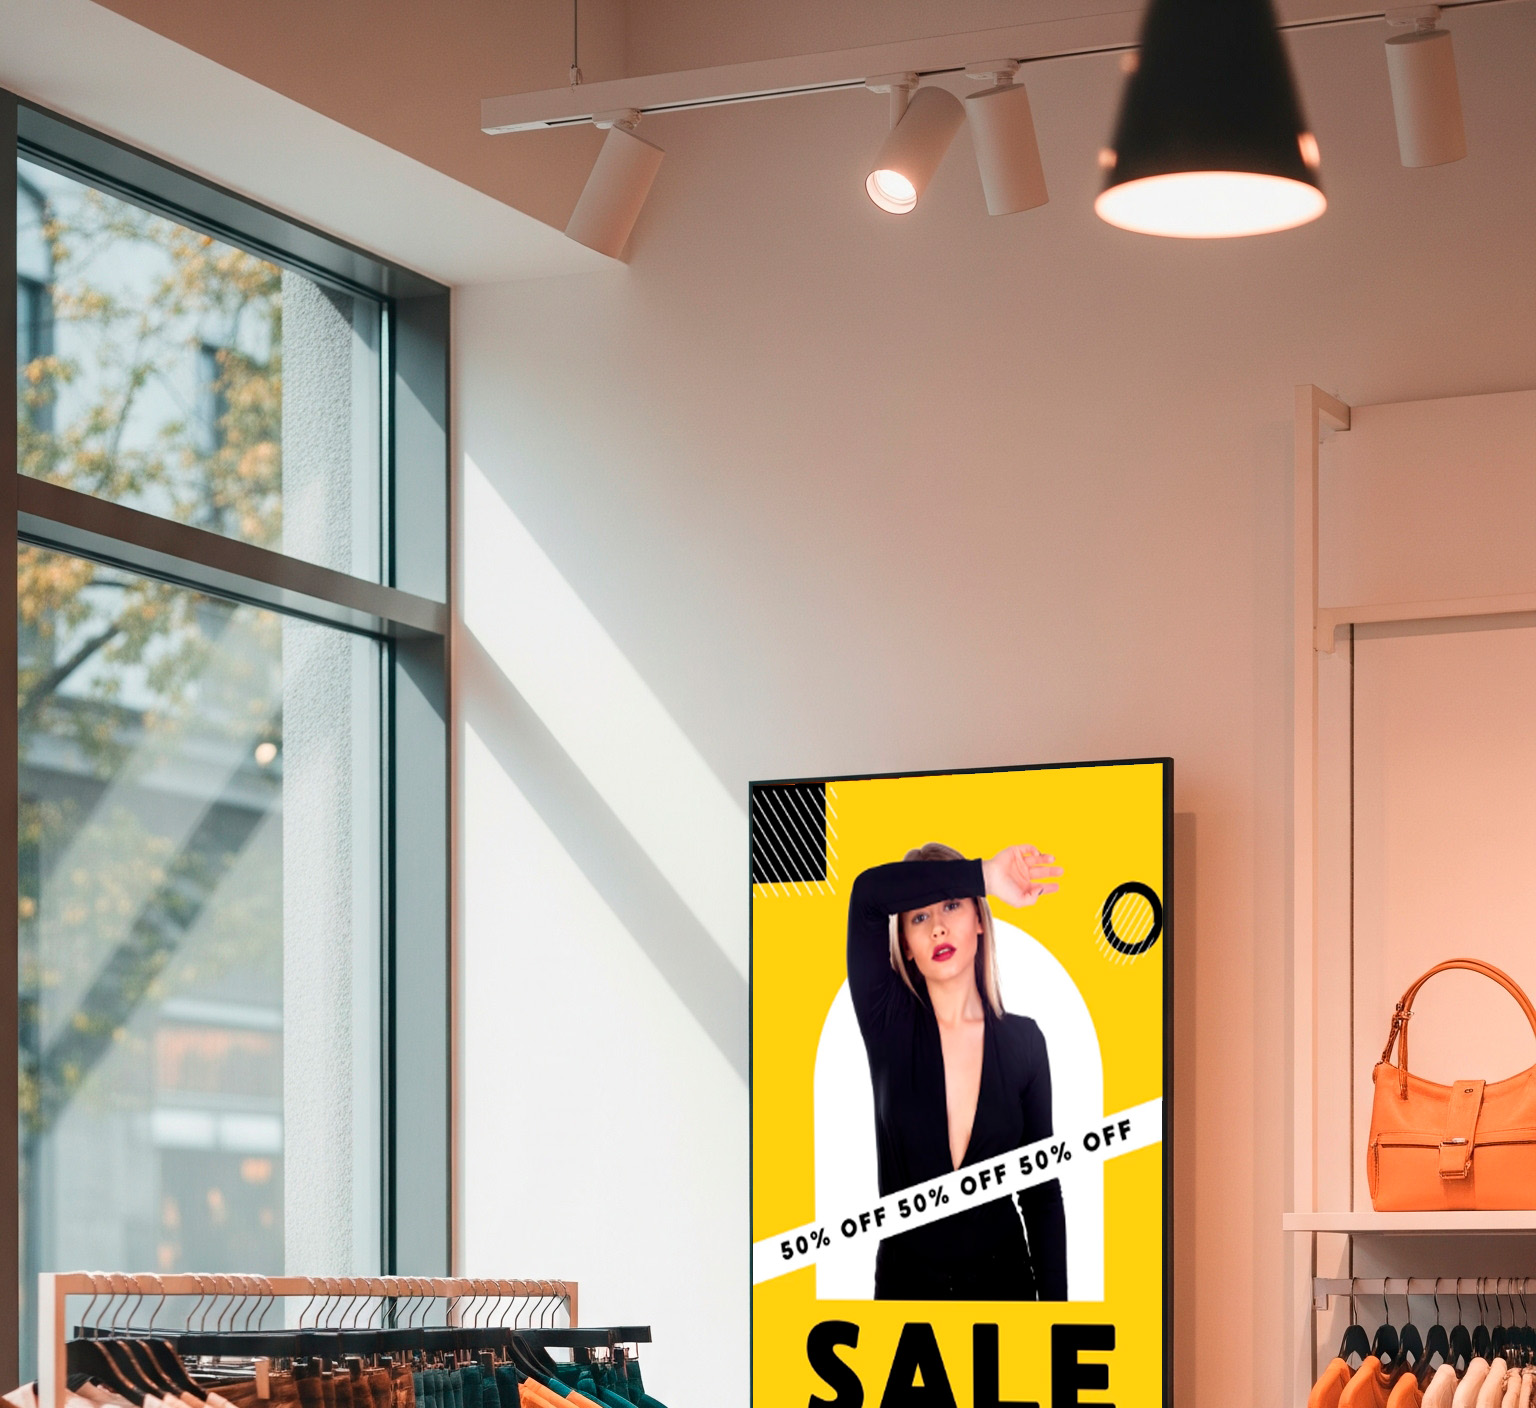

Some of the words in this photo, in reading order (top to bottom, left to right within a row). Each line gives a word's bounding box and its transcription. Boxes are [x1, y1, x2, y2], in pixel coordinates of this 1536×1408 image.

[780, 1227, 831, 1260] 50%
[840, 1206, 887, 1238] OFF
[897, 1185, 950, 1219] 50%
[960, 1163, 1007, 1196] OFF
[1018, 1141, 1072, 1176] 50%
[1083, 1119, 1132, 1152] OFF
